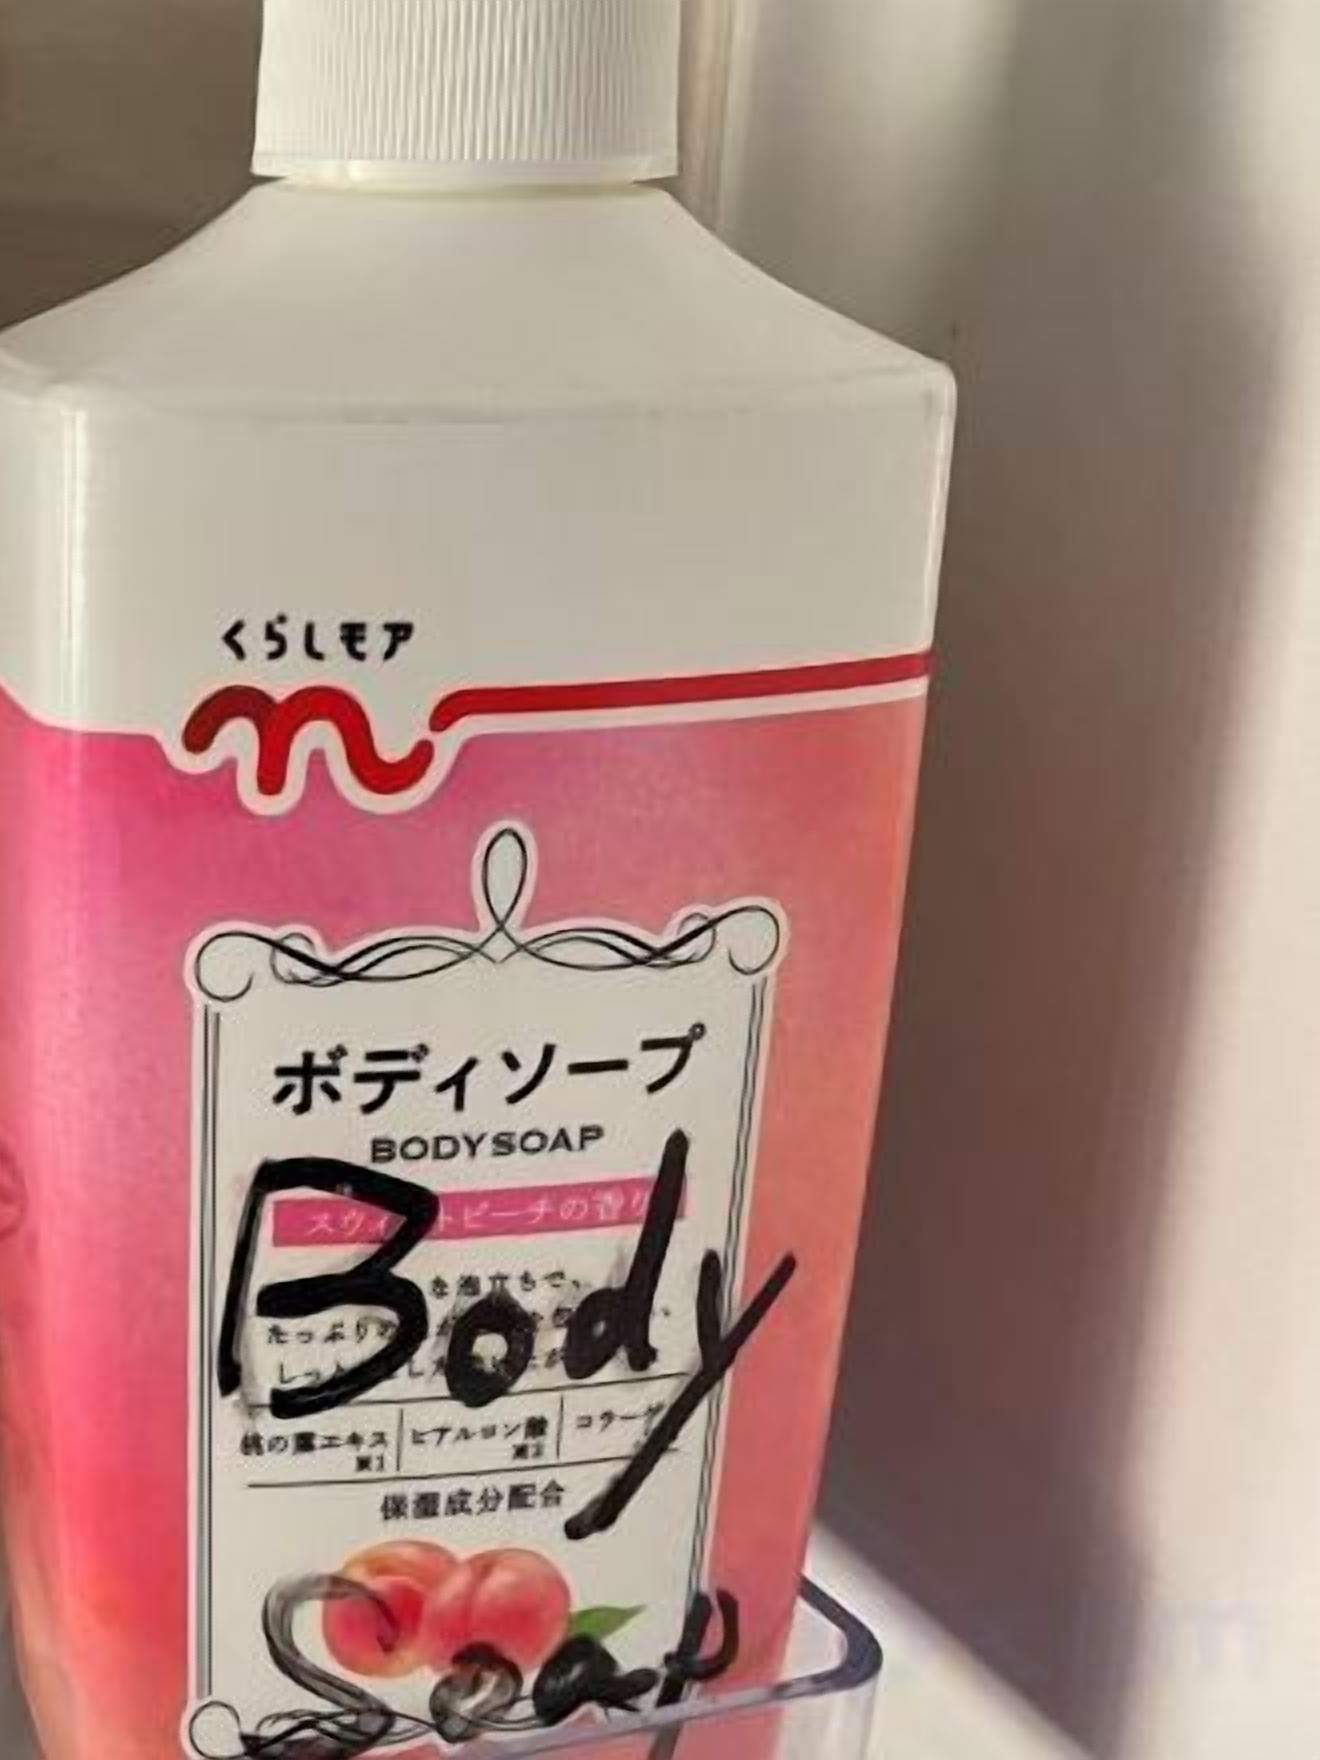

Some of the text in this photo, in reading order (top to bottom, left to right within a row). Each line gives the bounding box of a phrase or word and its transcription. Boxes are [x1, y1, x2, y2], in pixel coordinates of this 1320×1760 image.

[221, 612, 415, 662] くらしモア
[272, 1021, 707, 1116] ボディソープ
[218, 1127, 797, 1541] Body
[261, 1571, 740, 1760] Soap
